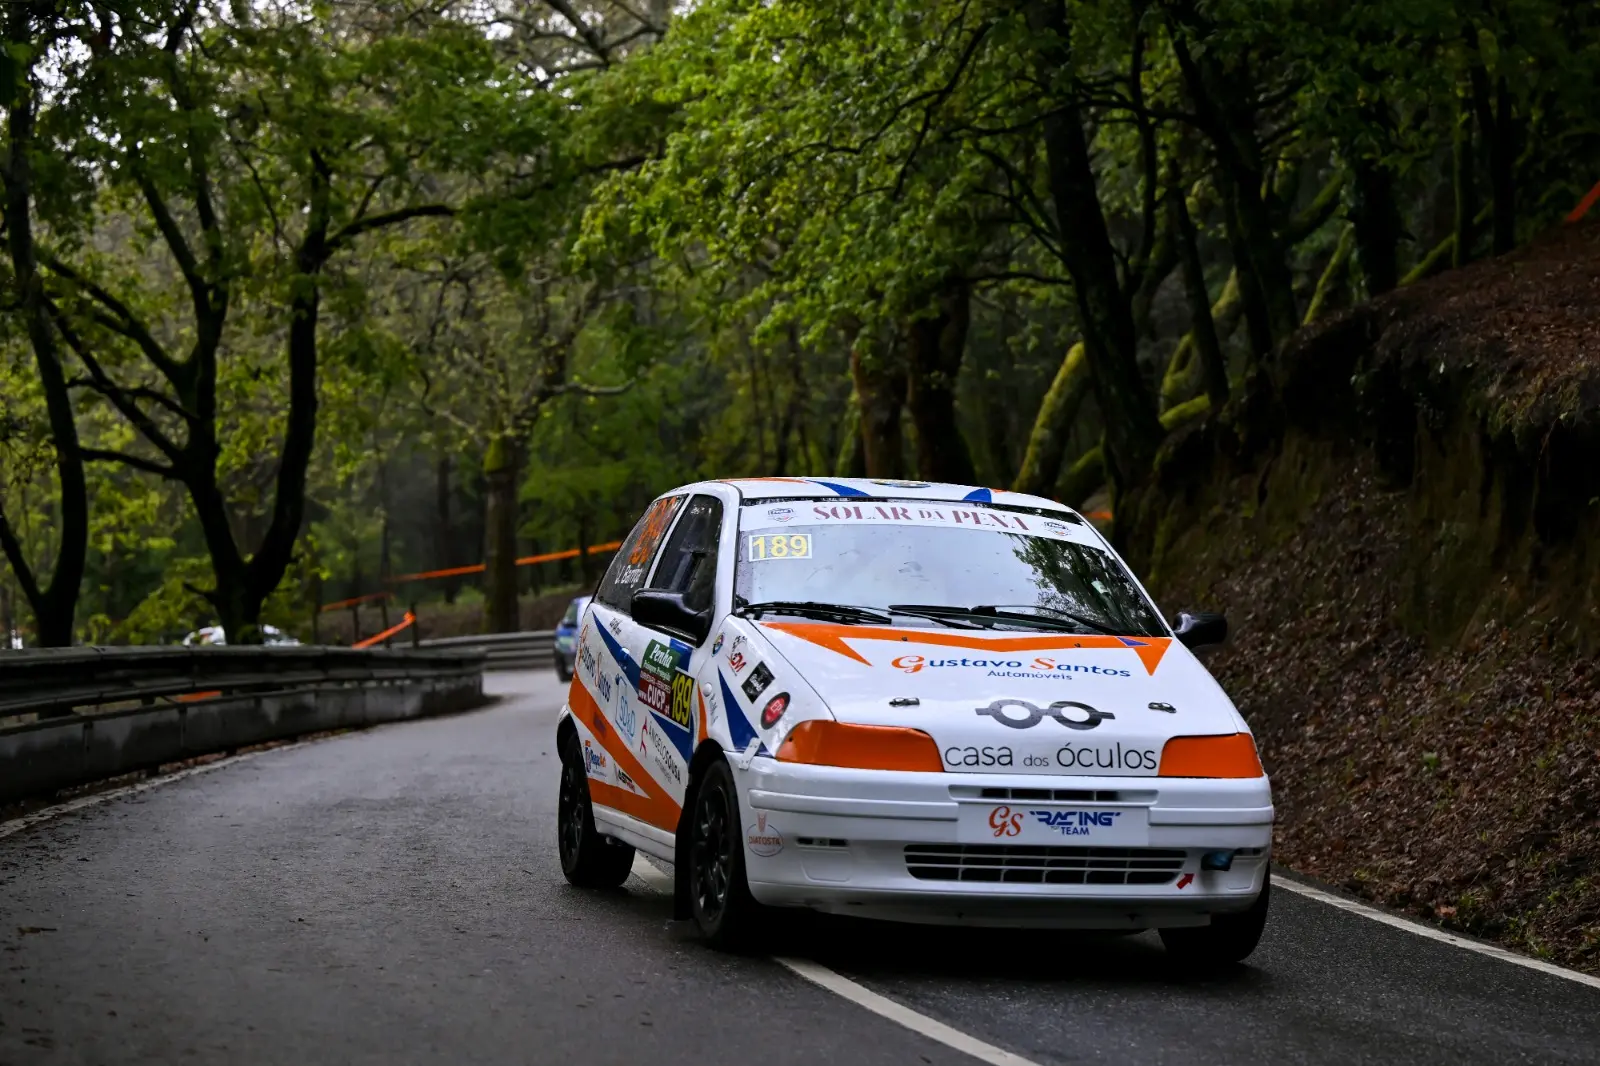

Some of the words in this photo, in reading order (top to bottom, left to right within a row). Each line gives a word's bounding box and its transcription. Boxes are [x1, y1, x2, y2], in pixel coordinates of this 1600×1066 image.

[813, 505, 913, 521] SOLAR
[918, 509, 946, 520] DA
[952, 510, 1029, 531] PENA
[752, 535, 808, 559] 189
[649, 643, 673, 669] Penha
[891, 655, 1022, 674] Gustavo
[1029, 657, 1131, 678] Santos
[987, 670, 1073, 681] Automóveis
[672, 672, 693, 725] 189
[944, 745, 1014, 767] casa
[1022, 753, 1050, 768] dos
[1056, 741, 1158, 771] óculos
[988, 805, 1024, 838] GS
[1030, 811, 1122, 827] RACING
[1060, 827, 1090, 836] TEAM
